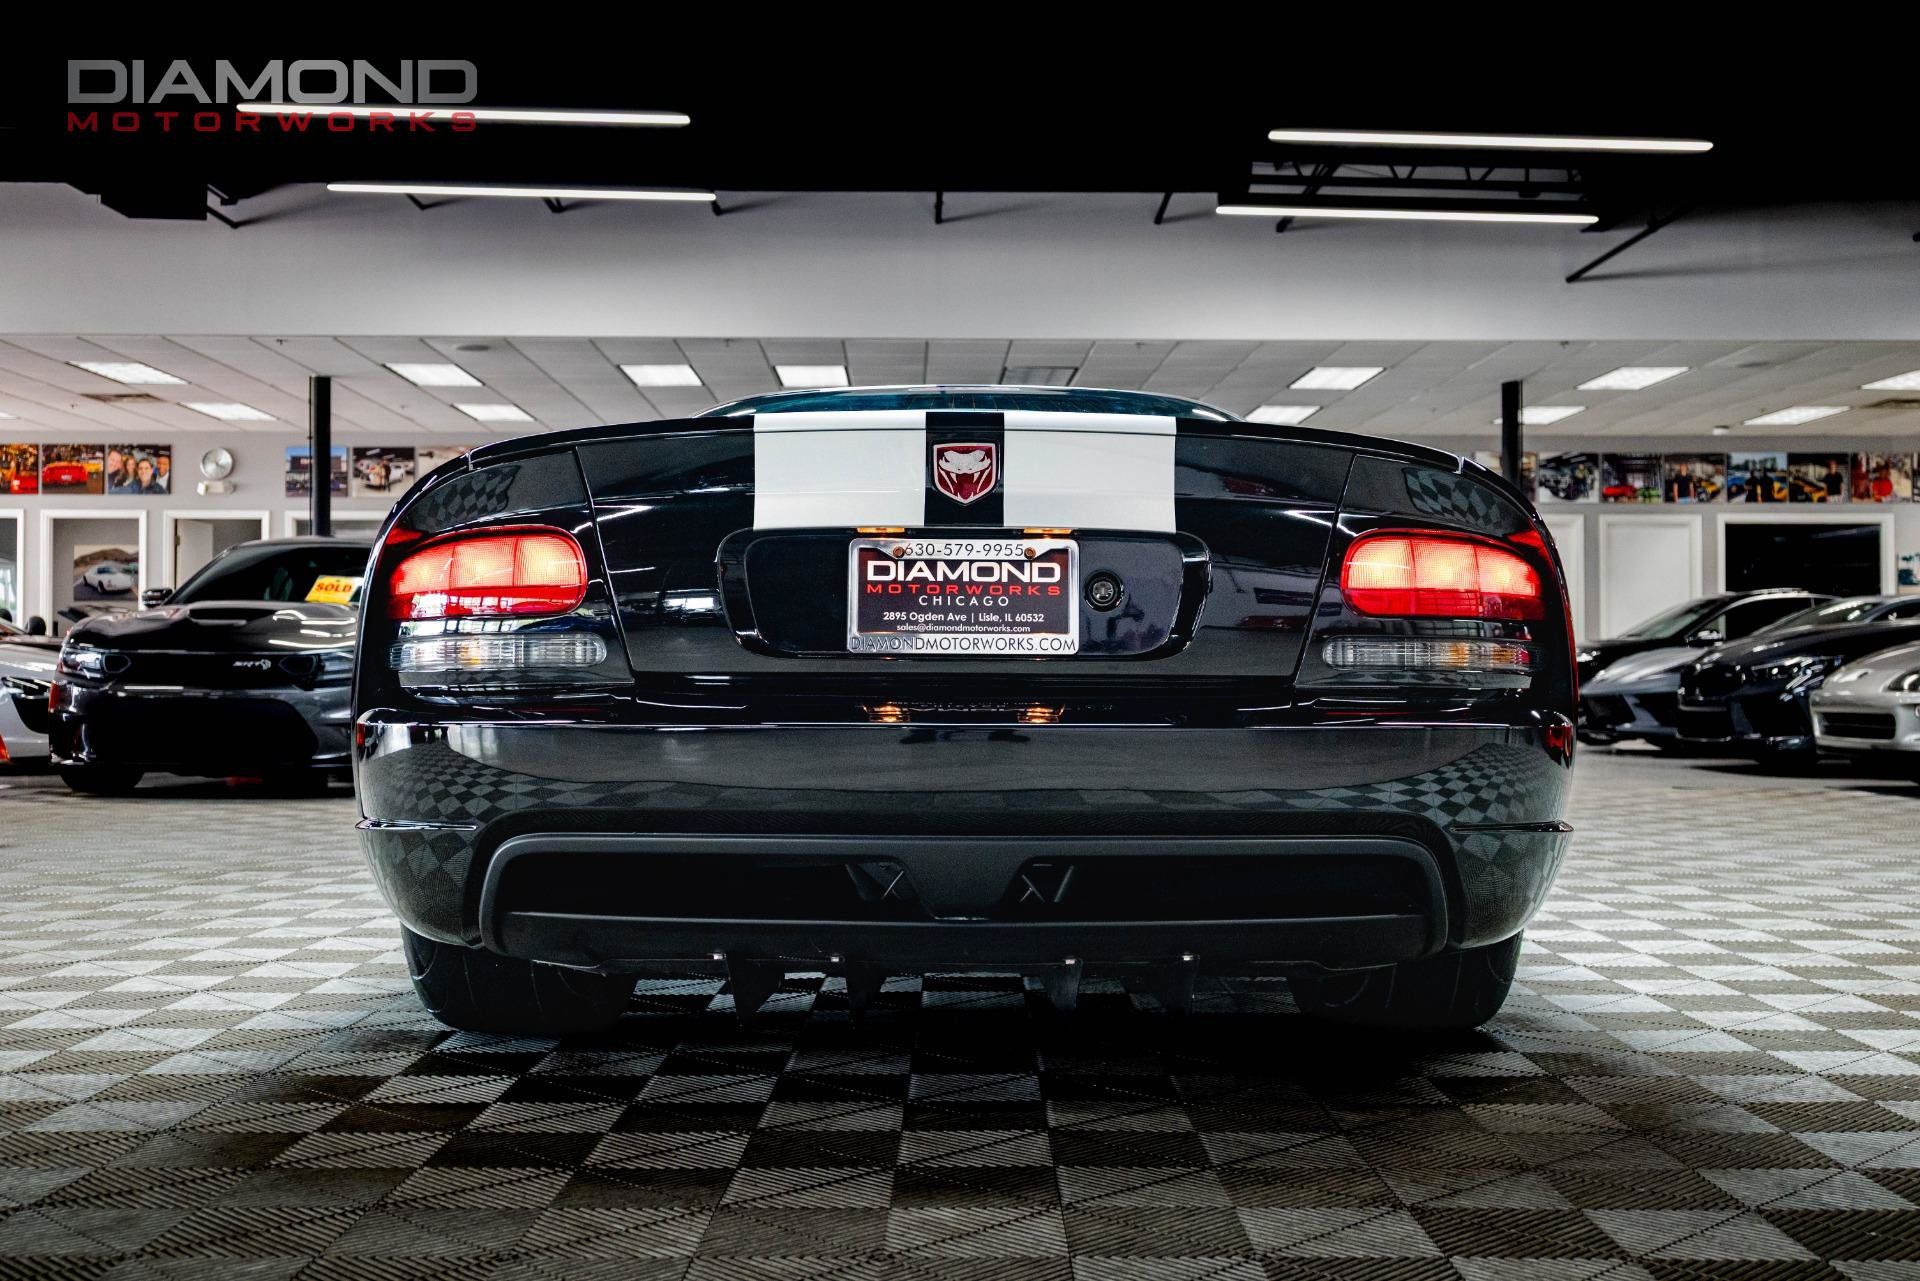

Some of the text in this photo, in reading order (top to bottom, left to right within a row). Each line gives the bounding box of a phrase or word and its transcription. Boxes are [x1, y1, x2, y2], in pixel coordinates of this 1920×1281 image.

[904, 543, 1024, 557] 630-579-9955
[867, 560, 1060, 582] DIAMOND
[315, 582, 352, 593] SOLD
[866, 584, 1061, 596] MOTORWORKS
[918, 595, 1009, 607] CHICAGO
[883, 612, 907, 621] 2895
[909, 611, 944, 623] Ogden
[947, 612, 967, 621] Ave
[978, 612, 1002, 622] Lisle,
[1004, 612, 1013, 621] IL
[1015, 612, 1045, 622] 60532
[896, 623, 1031, 633] sales@diamondmotorworks.com
[851, 636, 1077, 651] DIAMONDMOTORWORKS.COM
